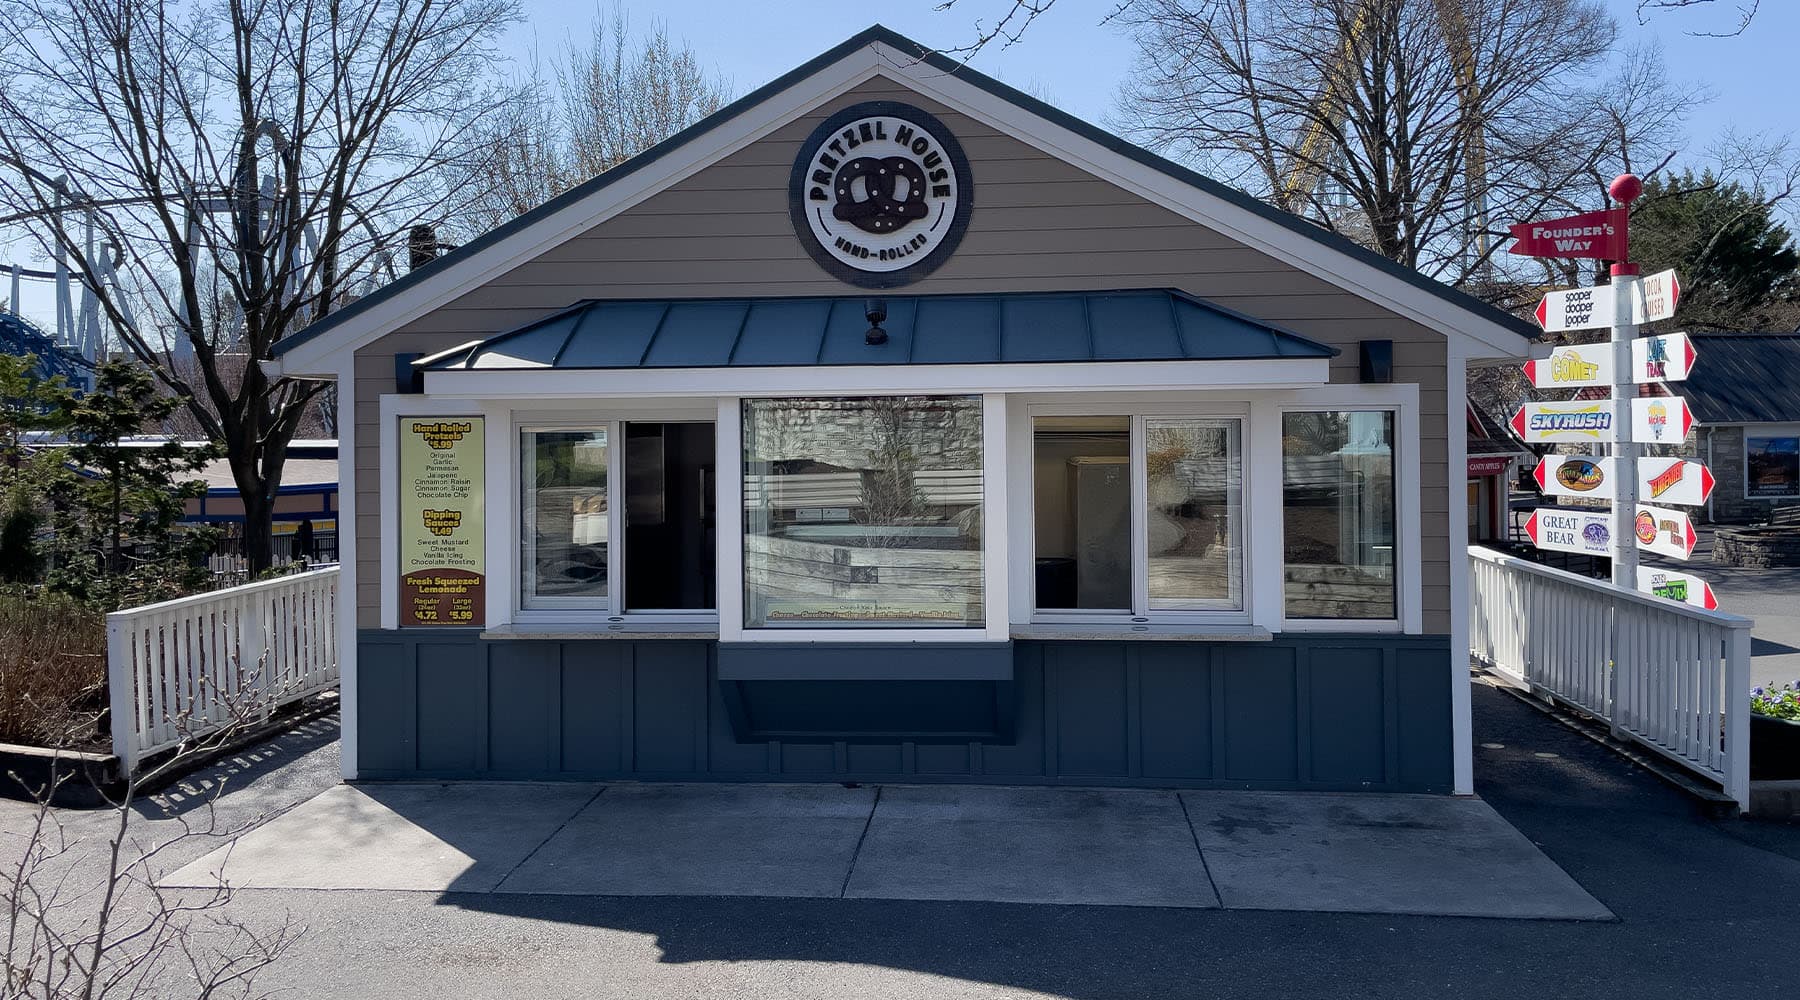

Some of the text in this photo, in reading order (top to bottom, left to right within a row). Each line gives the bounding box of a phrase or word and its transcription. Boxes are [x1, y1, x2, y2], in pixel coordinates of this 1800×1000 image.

[810, 121, 950, 200] PRETZEL HOUSE
[835, 233, 927, 261] HAND-ROLLED
[1565, 290, 1592, 302] sooper
[1565, 301, 1594, 313] dooper
[1551, 355, 1599, 382] COMET
[1530, 412, 1611, 430] SKYRUSH
[413, 423, 471, 432] Hand Rolled
[423, 509, 461, 520] Dipping
[424, 519, 460, 528] Sauces
[1543, 516, 1578, 530] GREAT
[1546, 531, 1575, 546] BEAR
[407, 577, 480, 587] Fresh Squeezed
[452, 597, 472, 605] Large
[415, 610, 473, 619] $4.72 $5.99
